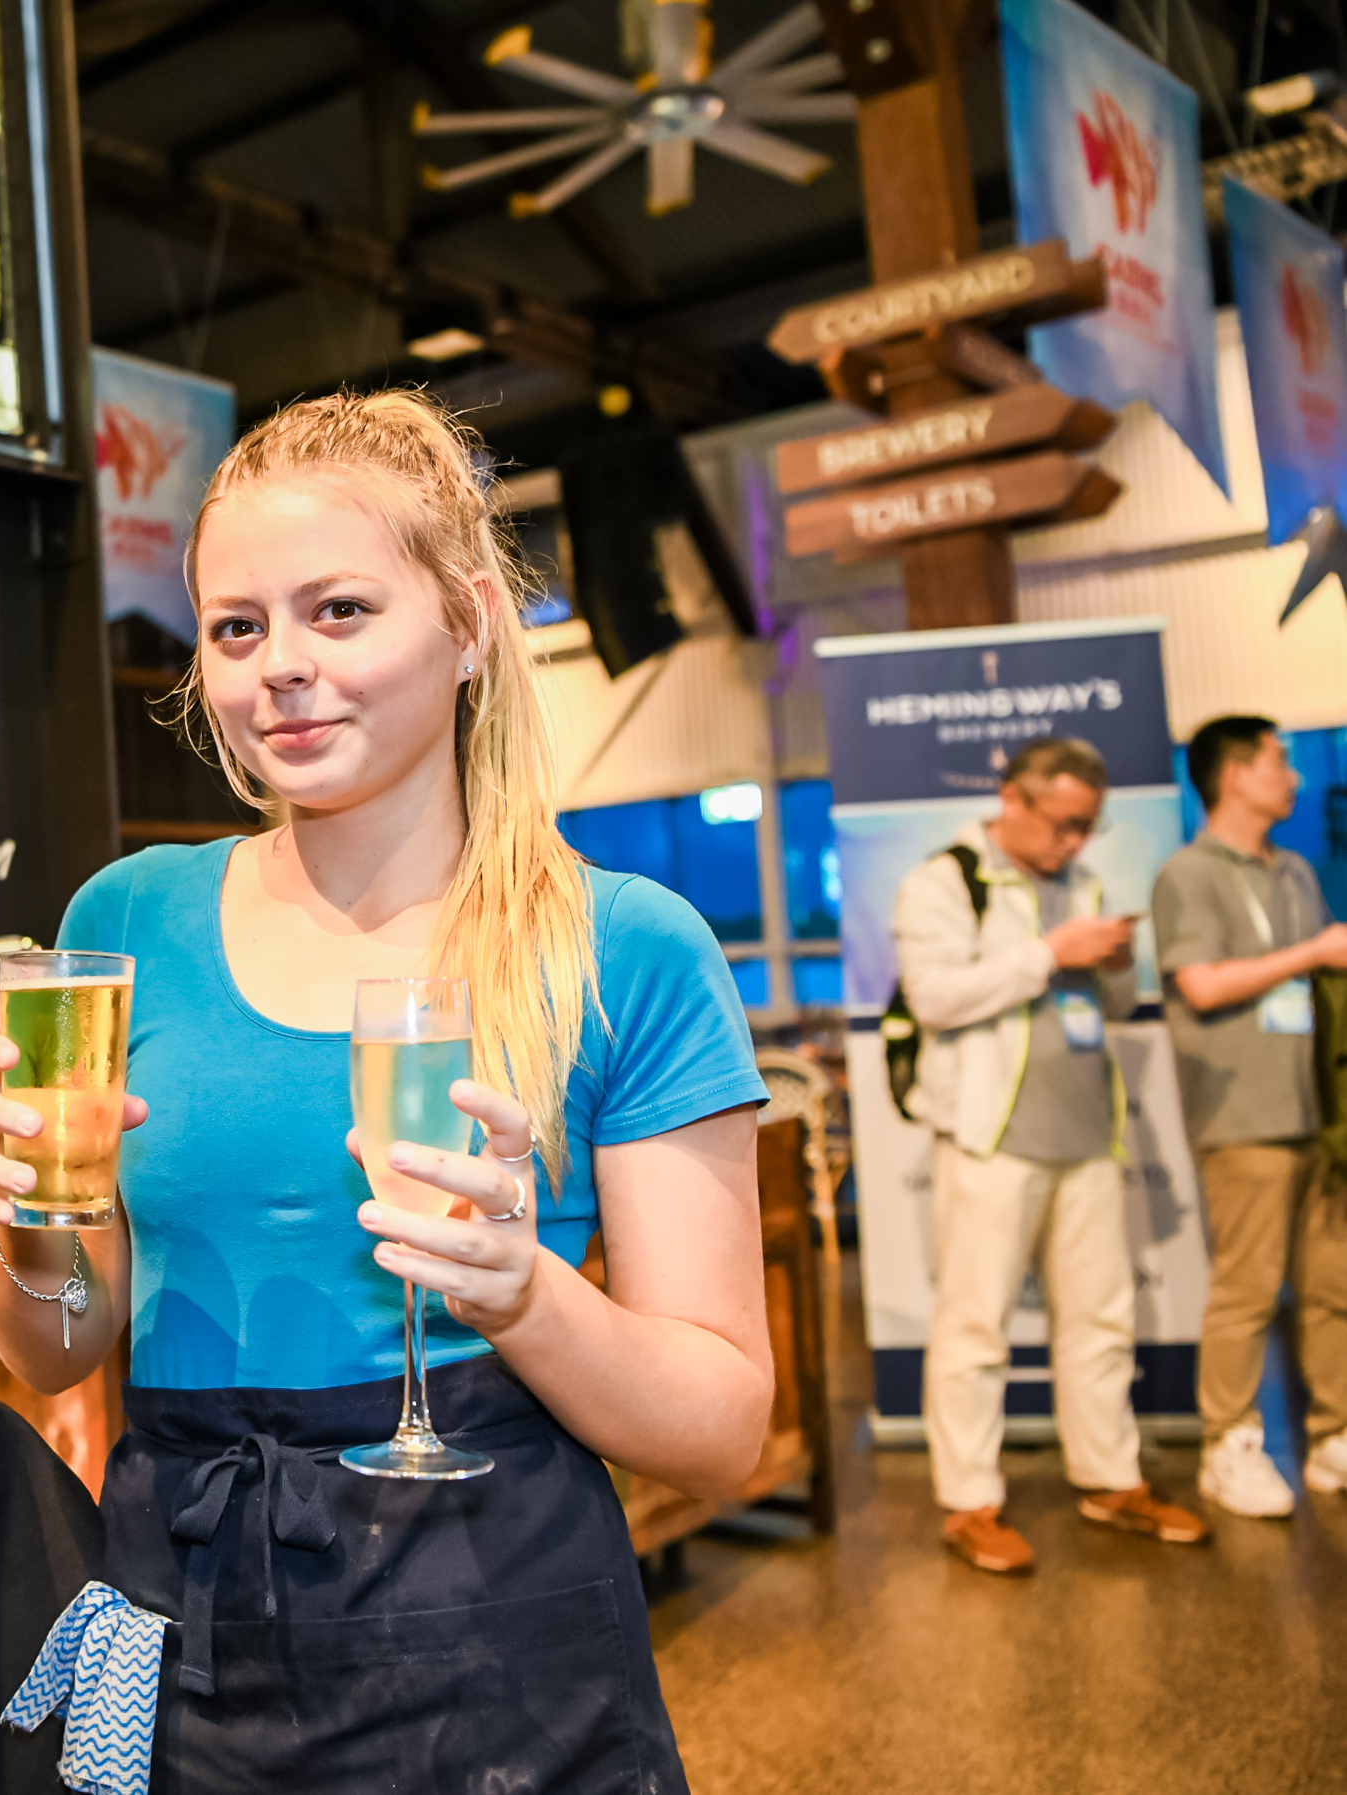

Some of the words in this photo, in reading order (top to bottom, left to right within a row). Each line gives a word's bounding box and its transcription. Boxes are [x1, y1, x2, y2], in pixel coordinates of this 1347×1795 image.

[813, 256, 1035, 344] COURTYARD
[817, 406, 993, 477] BREWERY
[851, 477, 996, 535] TOILETS
[866, 677, 1123, 726] HEMINGWAY'S
